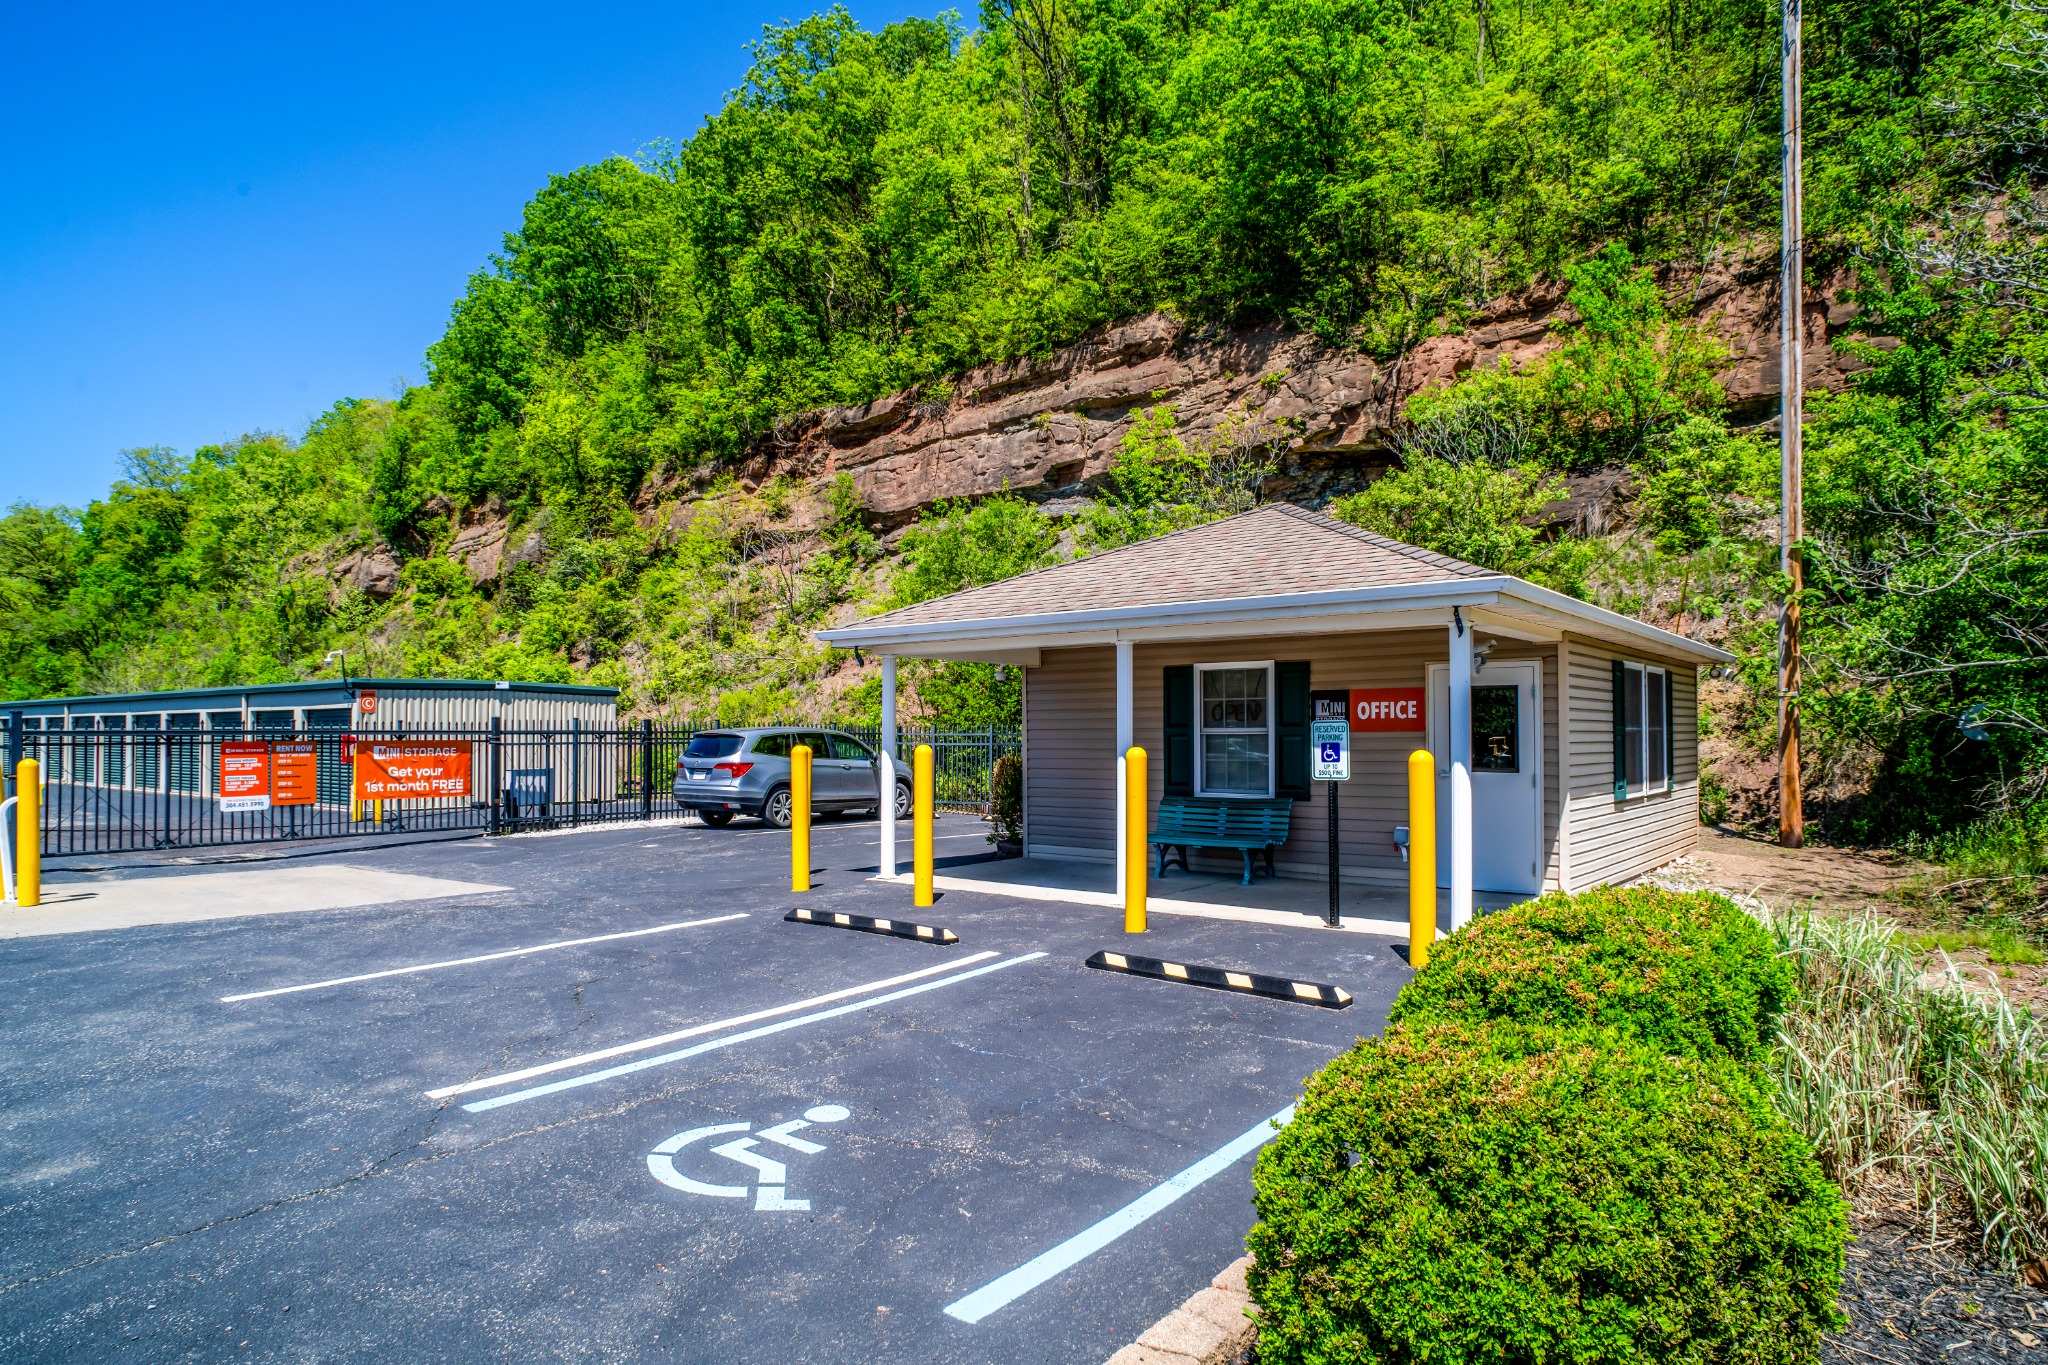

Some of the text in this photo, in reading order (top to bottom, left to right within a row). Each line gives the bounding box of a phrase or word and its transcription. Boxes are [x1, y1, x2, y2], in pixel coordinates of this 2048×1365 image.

[1319, 700, 1346, 713] MINI
[1357, 700, 1417, 720] OFFICE
[1314, 725, 1346, 733] RESERVED
[1317, 734, 1343, 742] PARKING
[295, 744, 313, 752] NOW
[376, 746, 457, 758] MINI STORAGE
[388, 766, 444, 779] Get your
[364, 779, 464, 792] 1st month FREE
